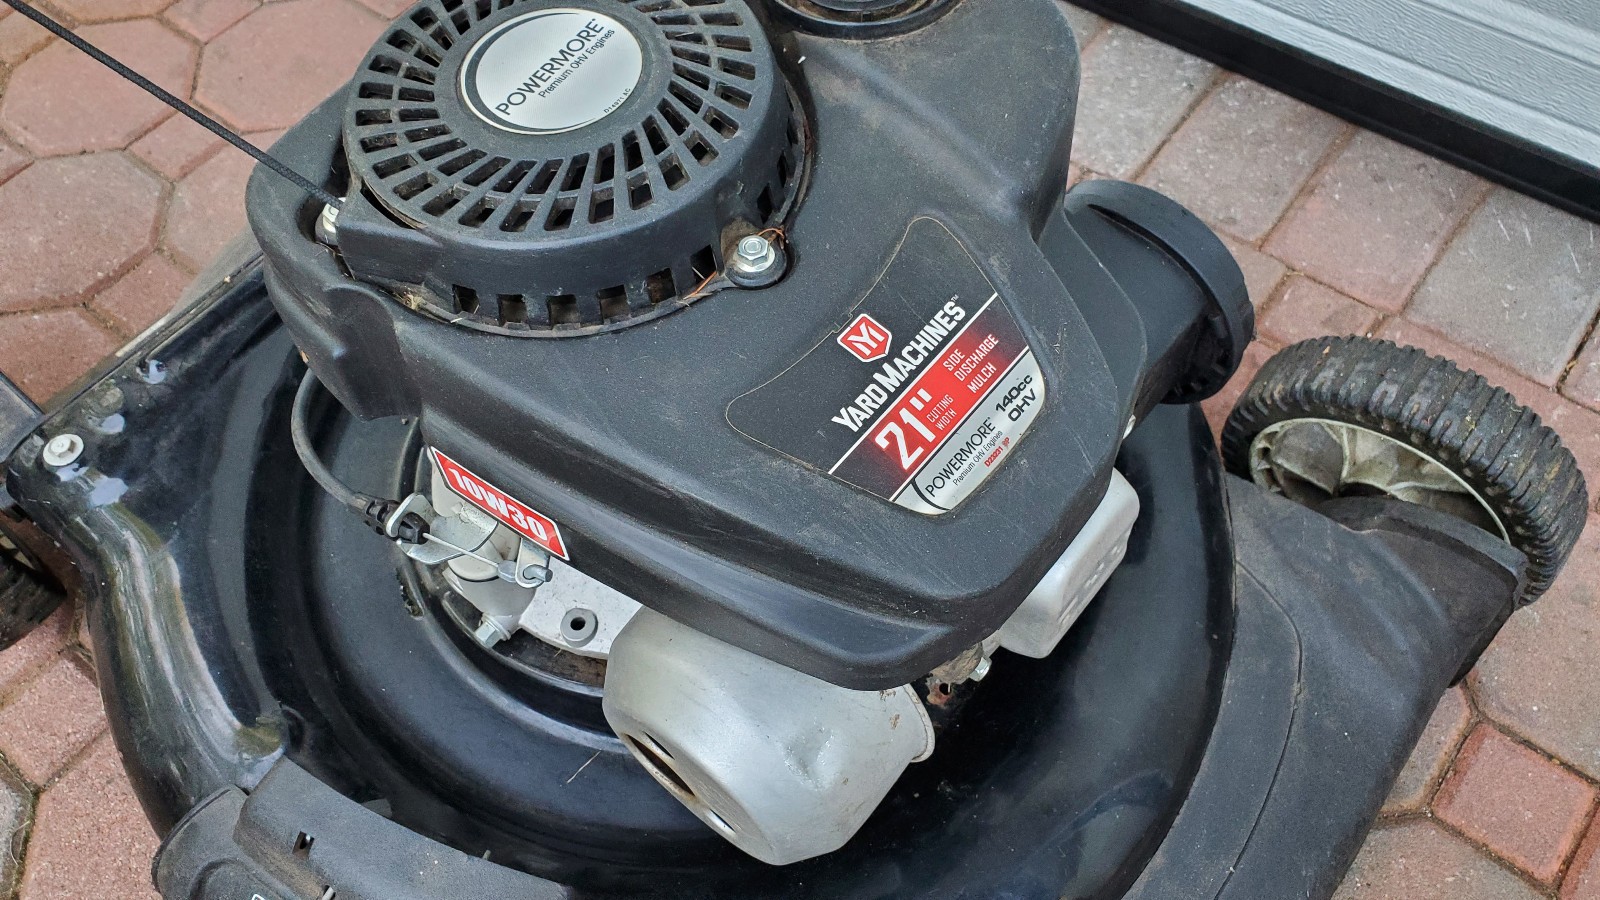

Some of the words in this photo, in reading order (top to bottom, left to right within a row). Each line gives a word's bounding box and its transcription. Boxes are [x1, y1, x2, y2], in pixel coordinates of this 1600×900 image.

[495, 19, 604, 115] POWERMORE
[538, 69, 573, 98] Premium
[570, 54, 588, 69] OHV
[587, 29, 615, 55] Engines
[622, 88, 631, 97] AC
[831, 383, 888, 433] YARD
[873, 300, 966, 393] MACHINES
[943, 348, 965, 372] SIDE
[954, 334, 999, 382] DISCHARGE
[967, 362, 997, 394] MULCH
[926, 394, 954, 423] CUTTING
[995, 374, 1033, 412] 140cc
[1007, 389, 1037, 422] OHV
[935, 408, 957, 431] WIDTH
[925, 416, 996, 498] POWERMORE
[953, 461, 976, 486] Premium
[973, 449, 986, 463] OHV
[982, 430, 1004, 452] Engines
[448, 467, 548, 541] 10W30
